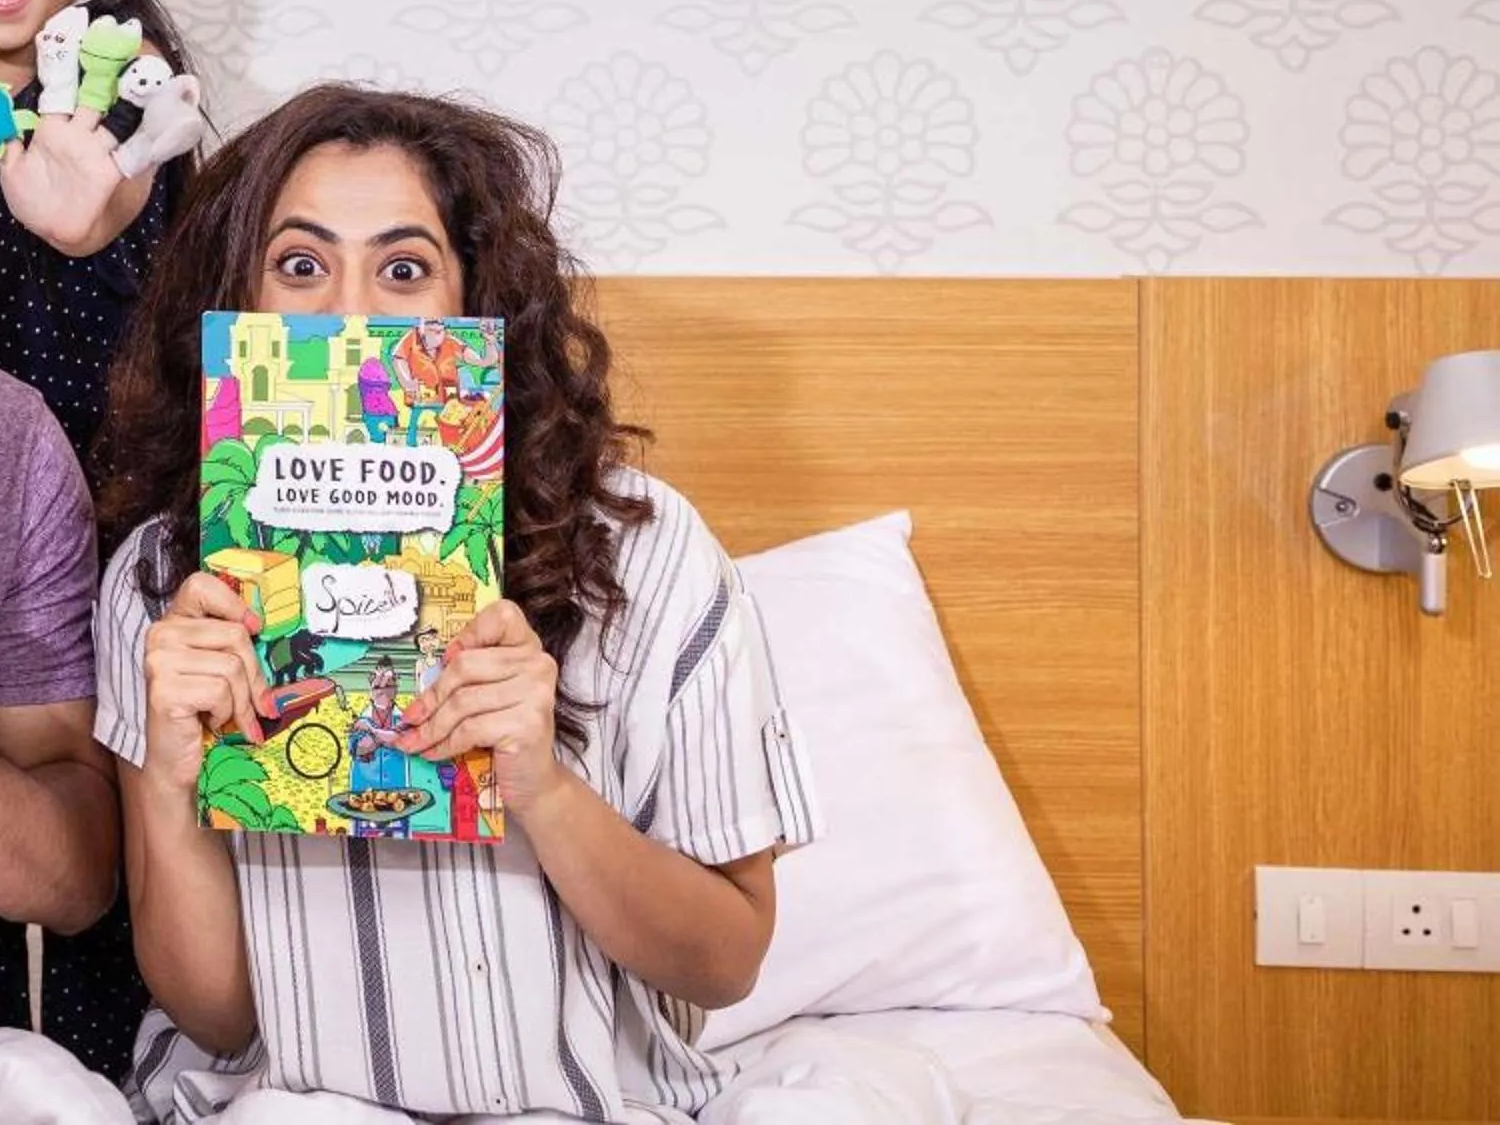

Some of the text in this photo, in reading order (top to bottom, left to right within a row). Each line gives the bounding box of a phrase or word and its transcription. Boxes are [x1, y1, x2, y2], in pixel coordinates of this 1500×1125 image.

[275, 457, 446, 485] LOVE FOOD.
[277, 488, 444, 508] LOVE GOOD MOOD.
